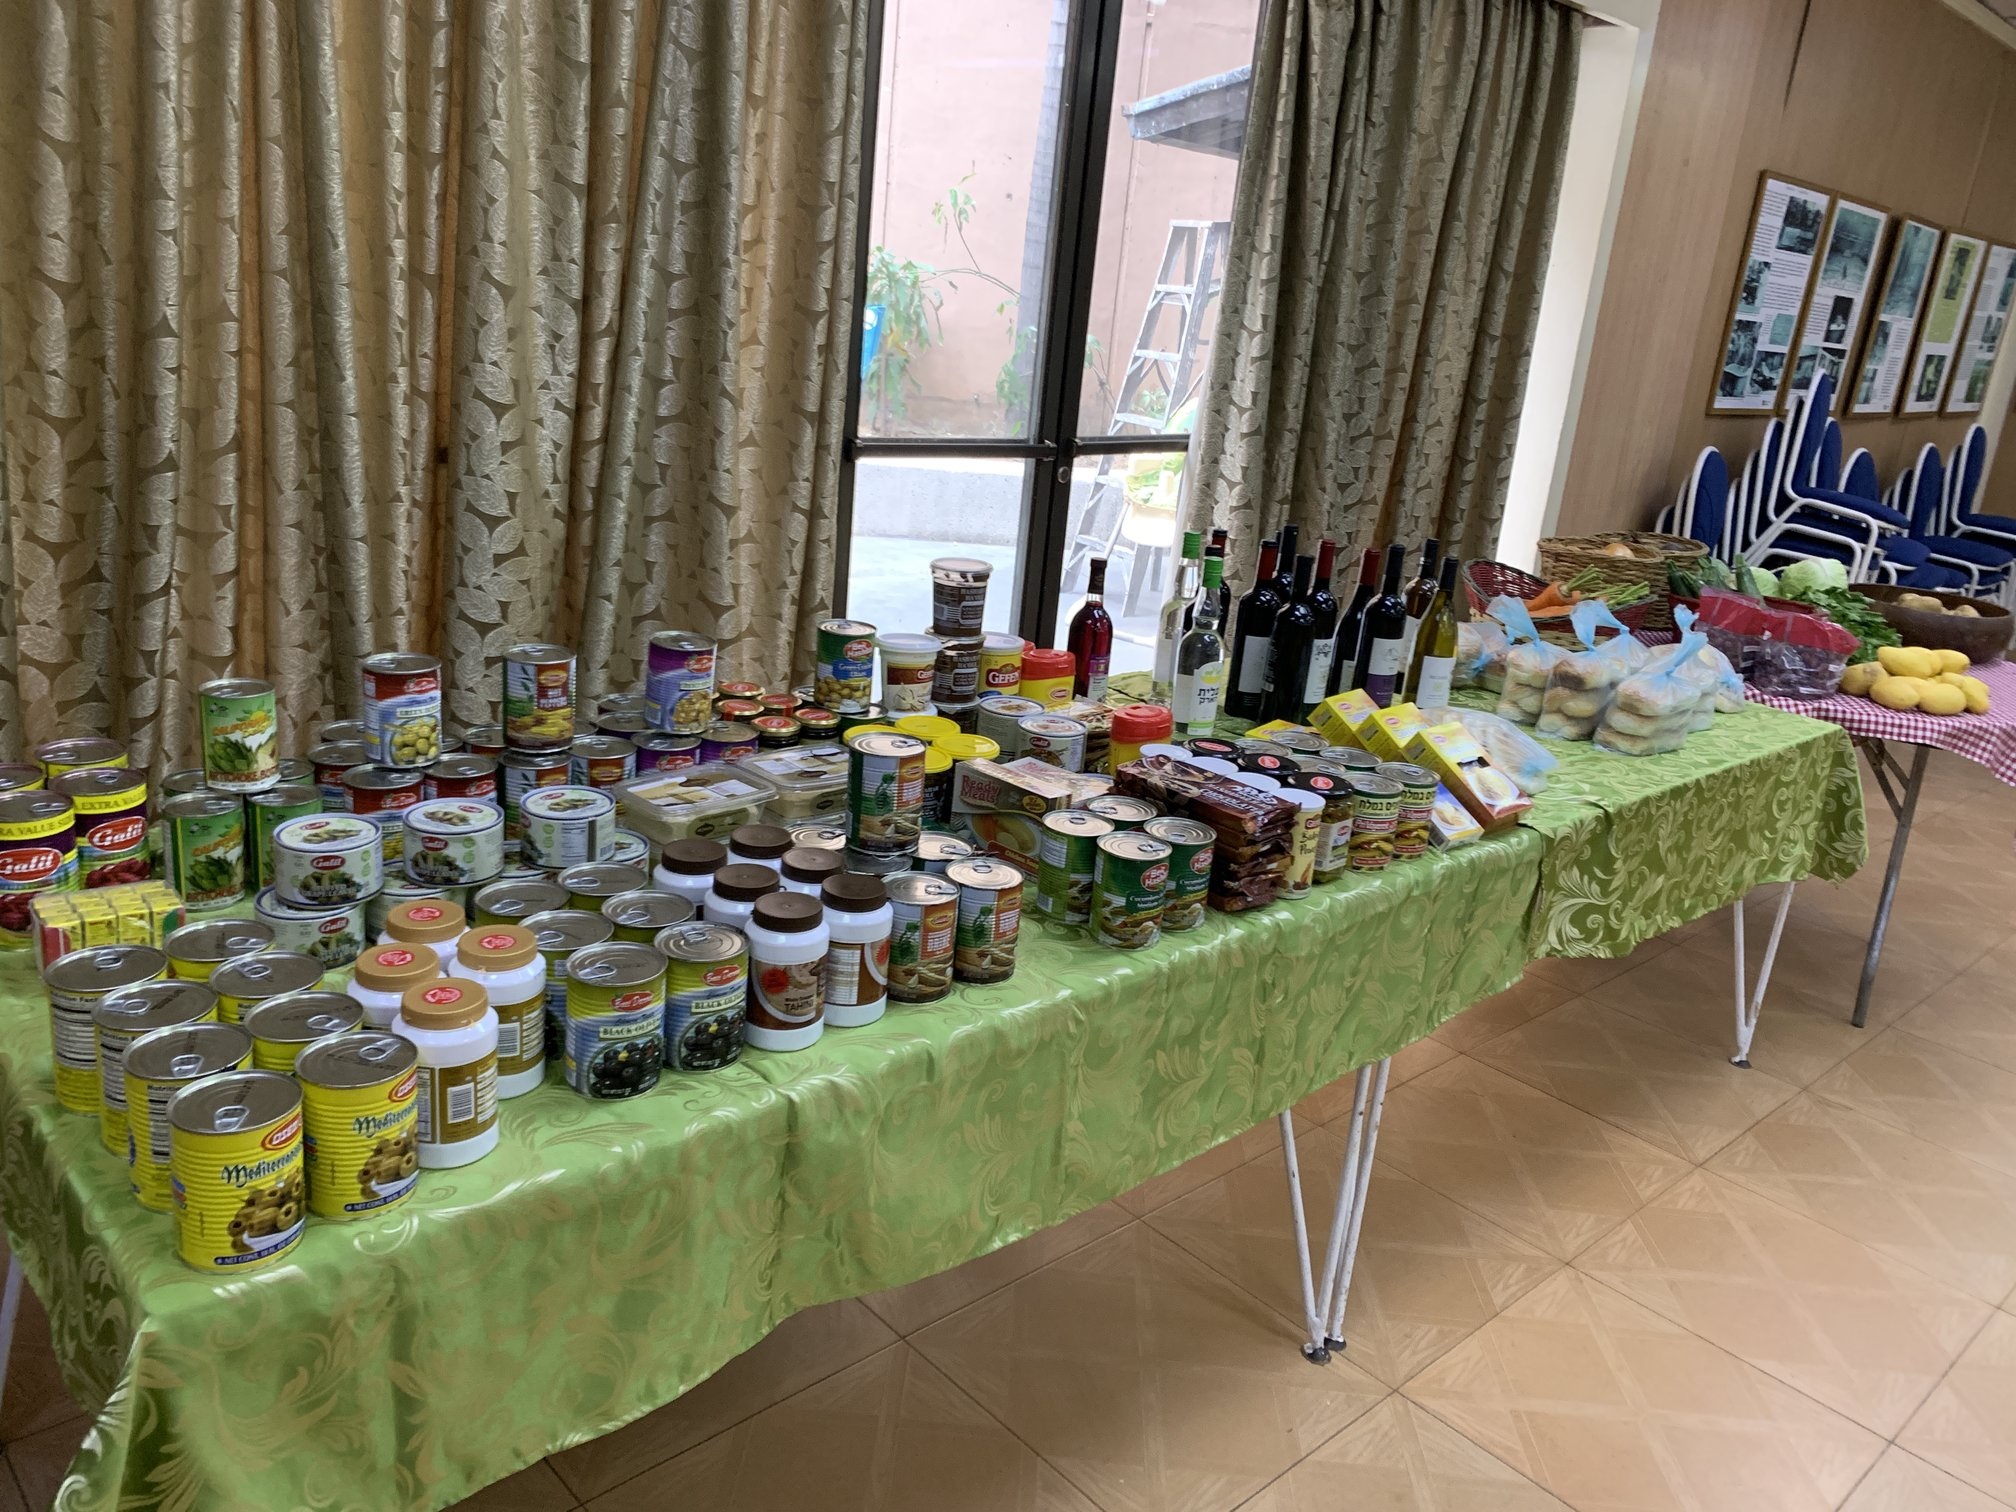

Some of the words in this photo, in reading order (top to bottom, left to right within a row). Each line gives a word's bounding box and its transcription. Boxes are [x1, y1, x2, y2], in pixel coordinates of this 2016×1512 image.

[988, 671, 1019, 684] GEFEN
[961, 774, 1001, 795] Ready
[960, 787, 998, 803] Meals
[81, 800, 115, 811] EXTRA
[92, 822, 144, 847] Galil
[603, 1027, 633, 1036] BLACK
